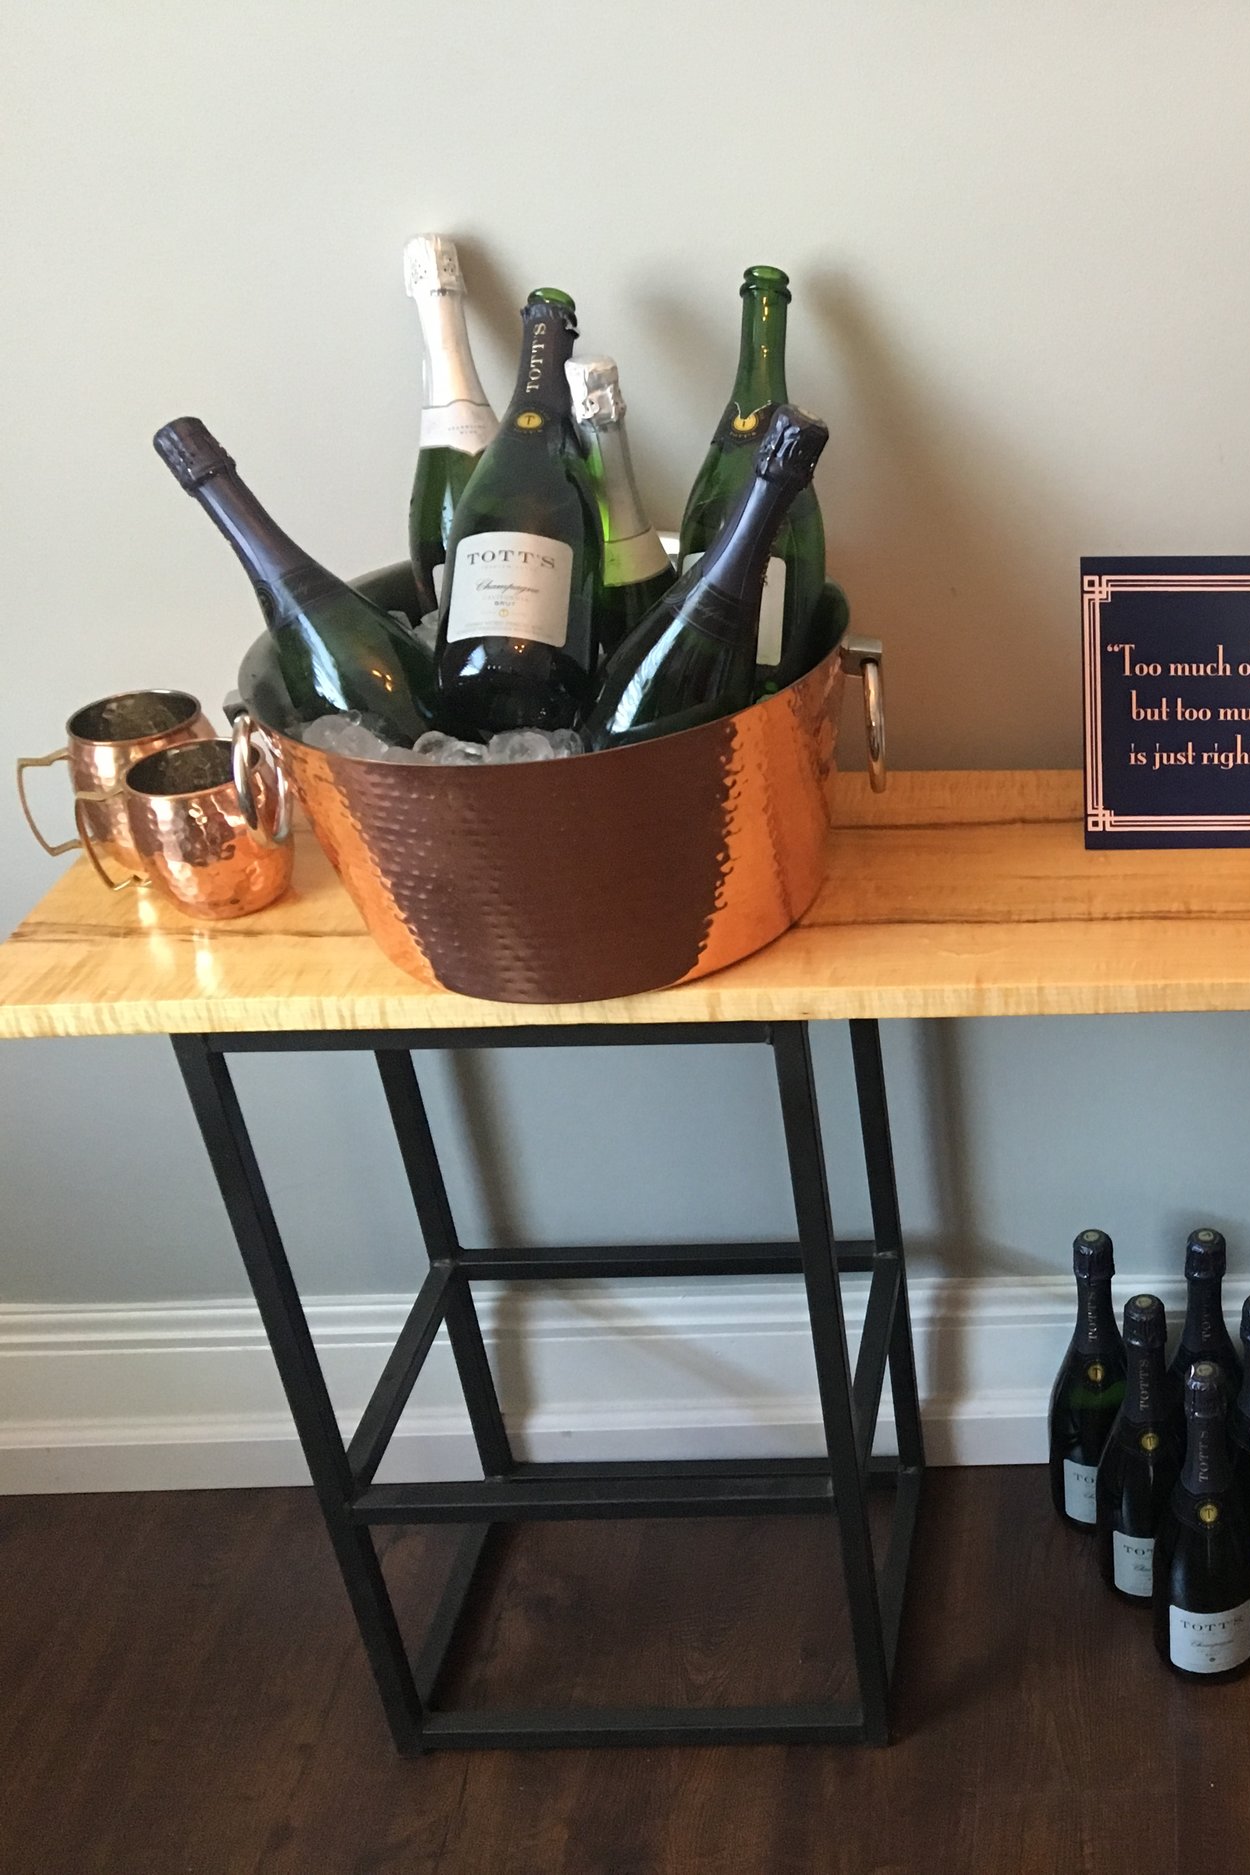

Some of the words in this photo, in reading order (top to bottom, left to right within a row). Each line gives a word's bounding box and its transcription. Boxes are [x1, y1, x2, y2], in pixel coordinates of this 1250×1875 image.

[526, 323, 546, 393] TOTT'S
[467, 550, 556, 569] TOTT'S
[475, 579, 540, 596] Champagne
[1169, 644, 1232, 676] much
[1130, 689, 1170, 721] but
[1176, 697, 1212, 721] too
[1129, 743, 1148, 765] is
[1152, 741, 1195, 770] just
